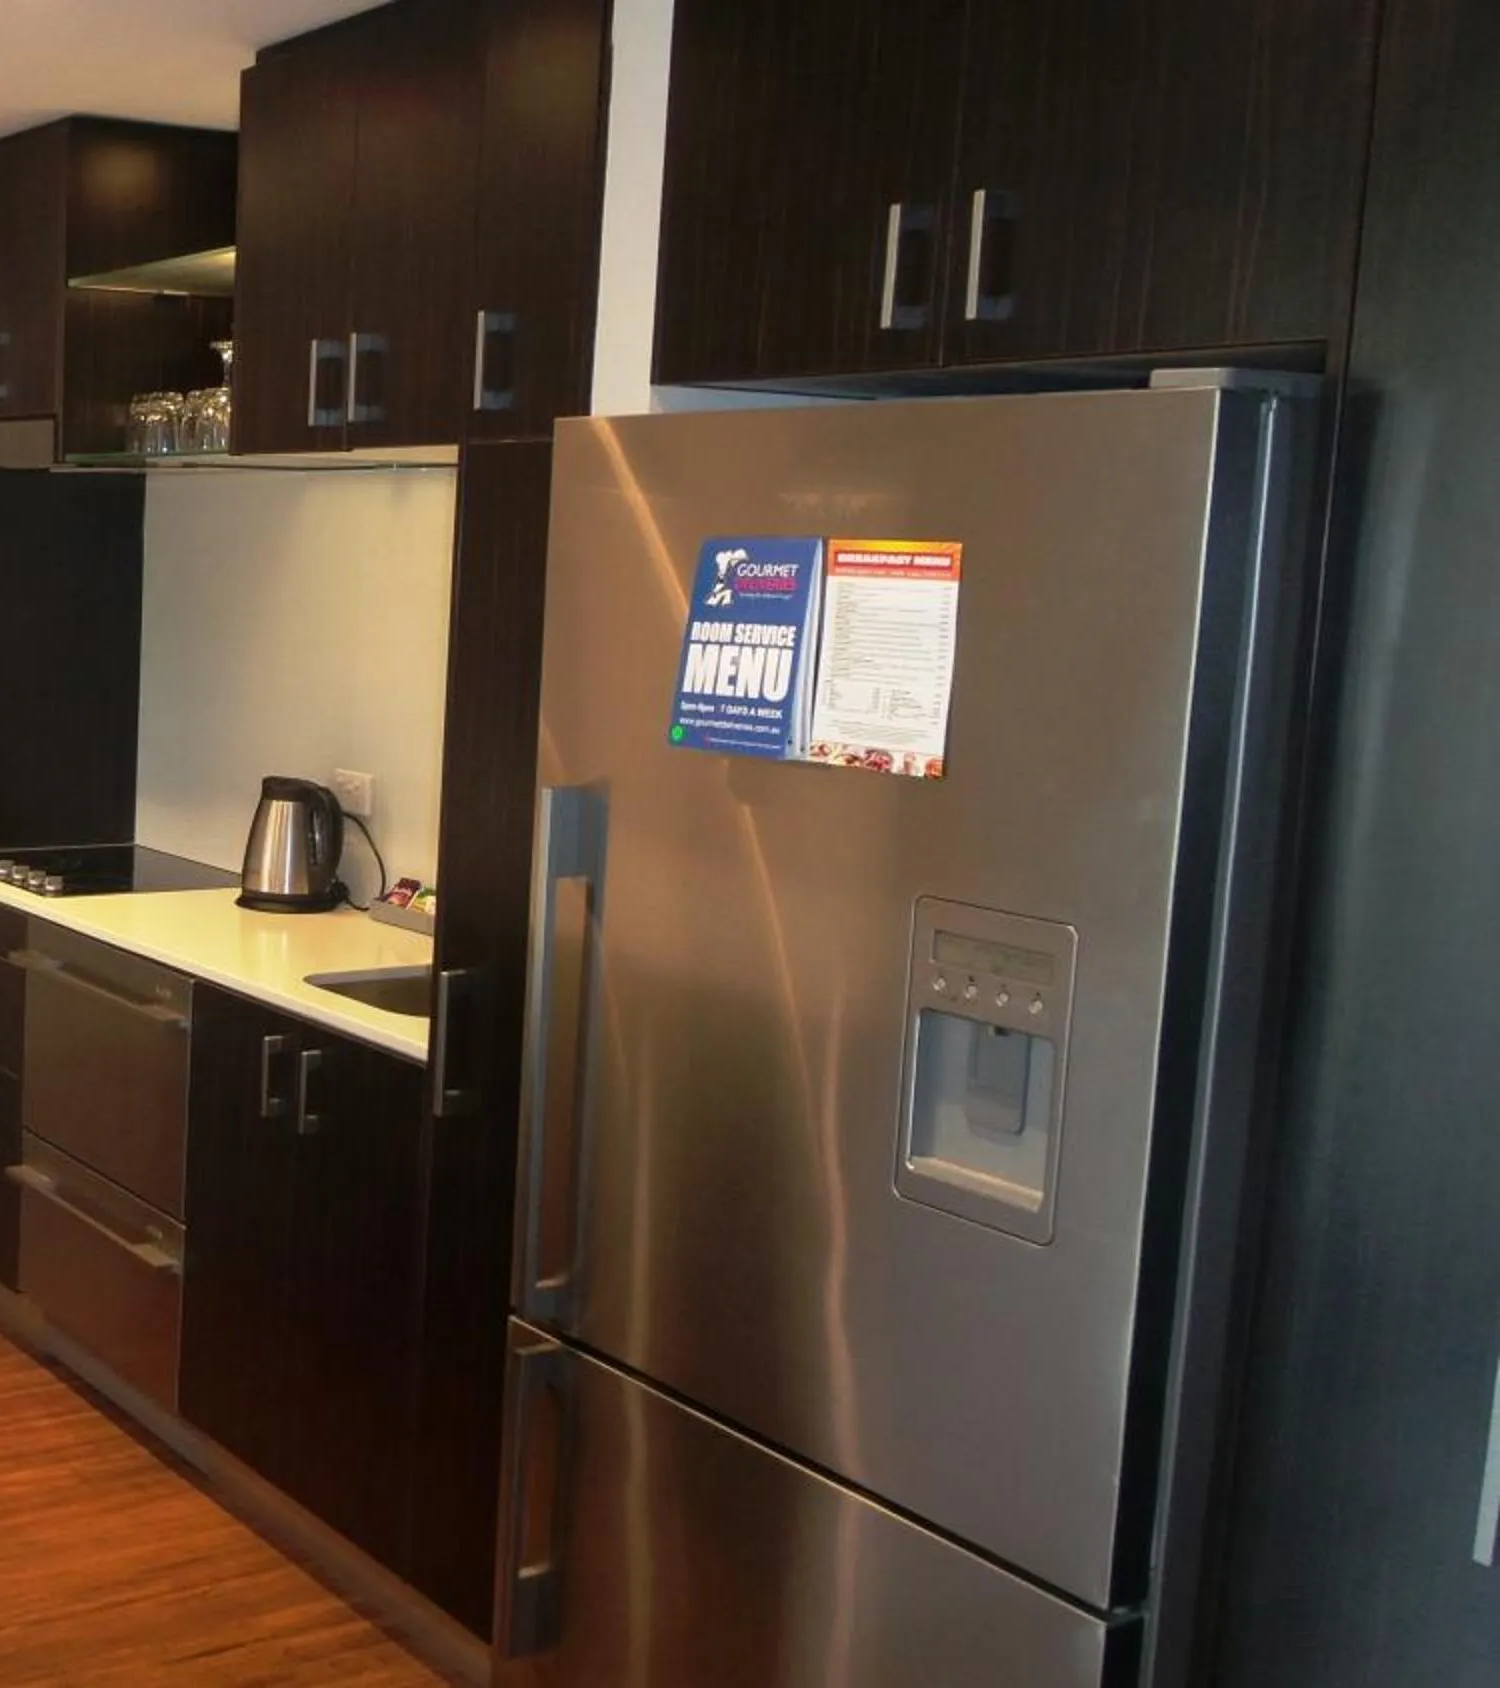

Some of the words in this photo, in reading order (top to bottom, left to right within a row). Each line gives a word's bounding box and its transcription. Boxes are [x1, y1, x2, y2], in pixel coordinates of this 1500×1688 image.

[736, 562, 800, 578] GOURMET
[690, 621, 734, 642] ROOM
[733, 623, 797, 648] SERVICE
[681, 643, 794, 702] MENU
